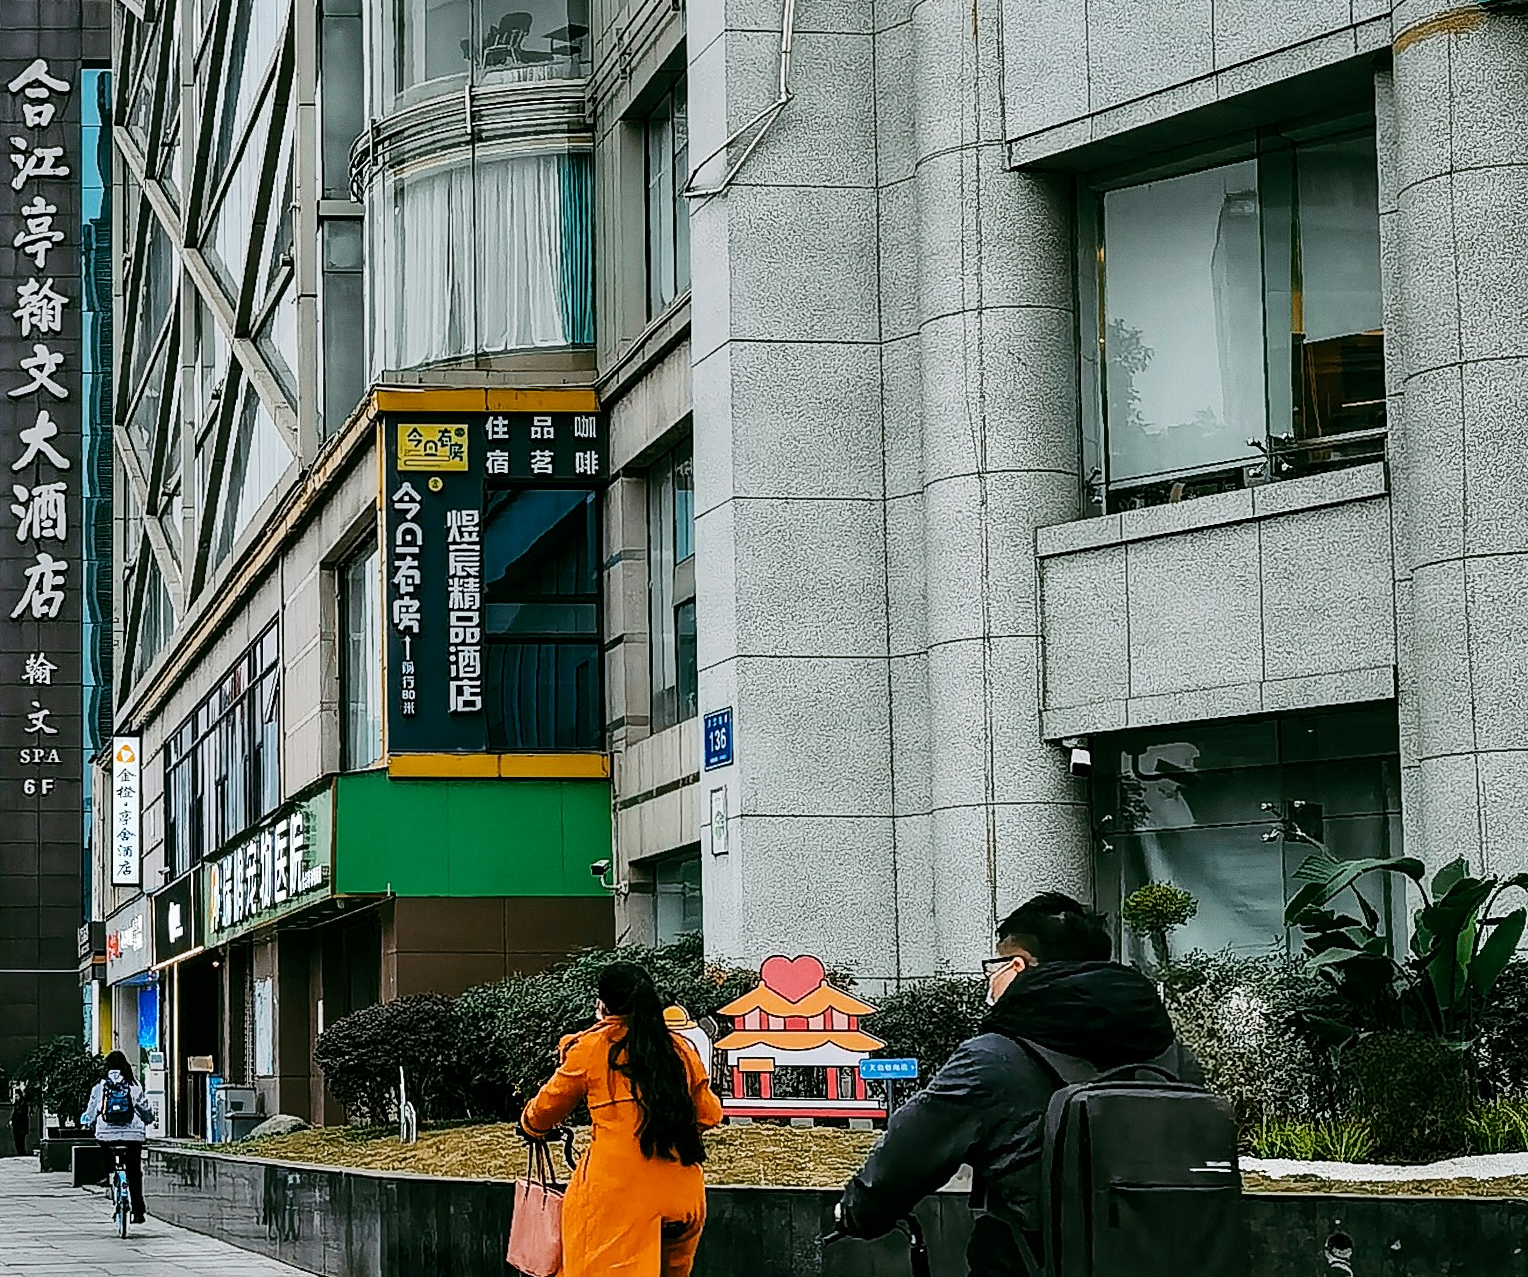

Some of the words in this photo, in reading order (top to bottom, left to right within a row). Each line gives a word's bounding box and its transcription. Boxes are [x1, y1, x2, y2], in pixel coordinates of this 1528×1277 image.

[7, 58, 71, 621] 合江亭翰文大酒店
[486, 416, 510, 475] 住宿
[530, 416, 555, 475] 品茗
[575, 415, 599, 475] 咖啡
[21, 652, 59, 735] 翰文
[19, 748, 63, 764] SPA
[708, 729, 727, 753] 136
[23, 778, 54, 795] 6F
